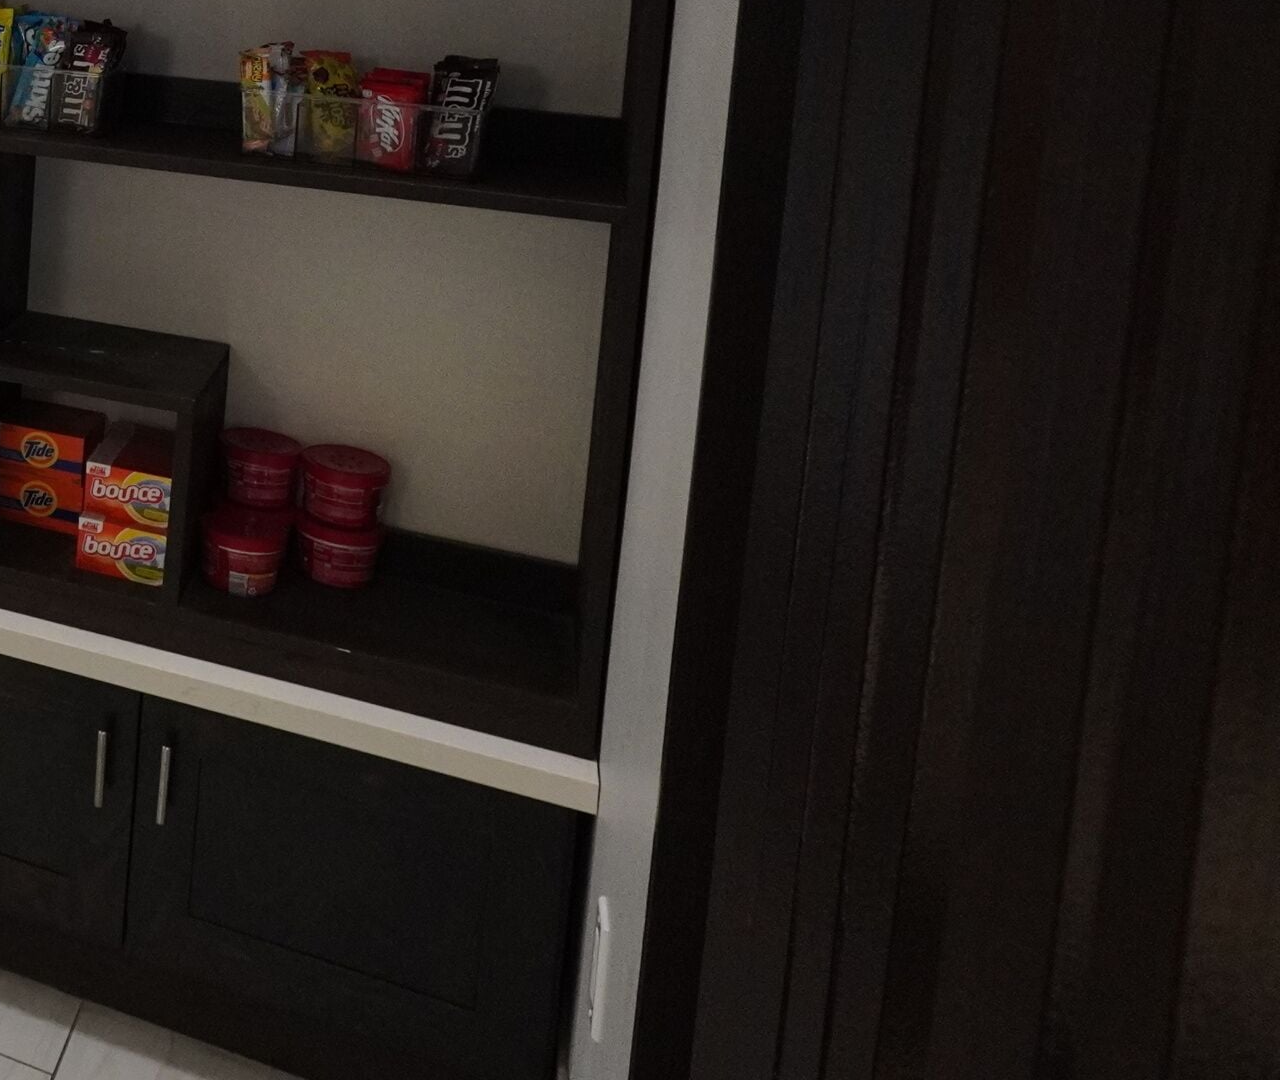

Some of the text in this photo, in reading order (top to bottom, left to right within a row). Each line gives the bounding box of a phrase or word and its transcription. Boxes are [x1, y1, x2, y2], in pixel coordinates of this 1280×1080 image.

[24, 439, 55, 459] Tide
[23, 489, 54, 508] Tide
[92, 478, 164, 504] bounce
[83, 534, 157, 561] bounce
